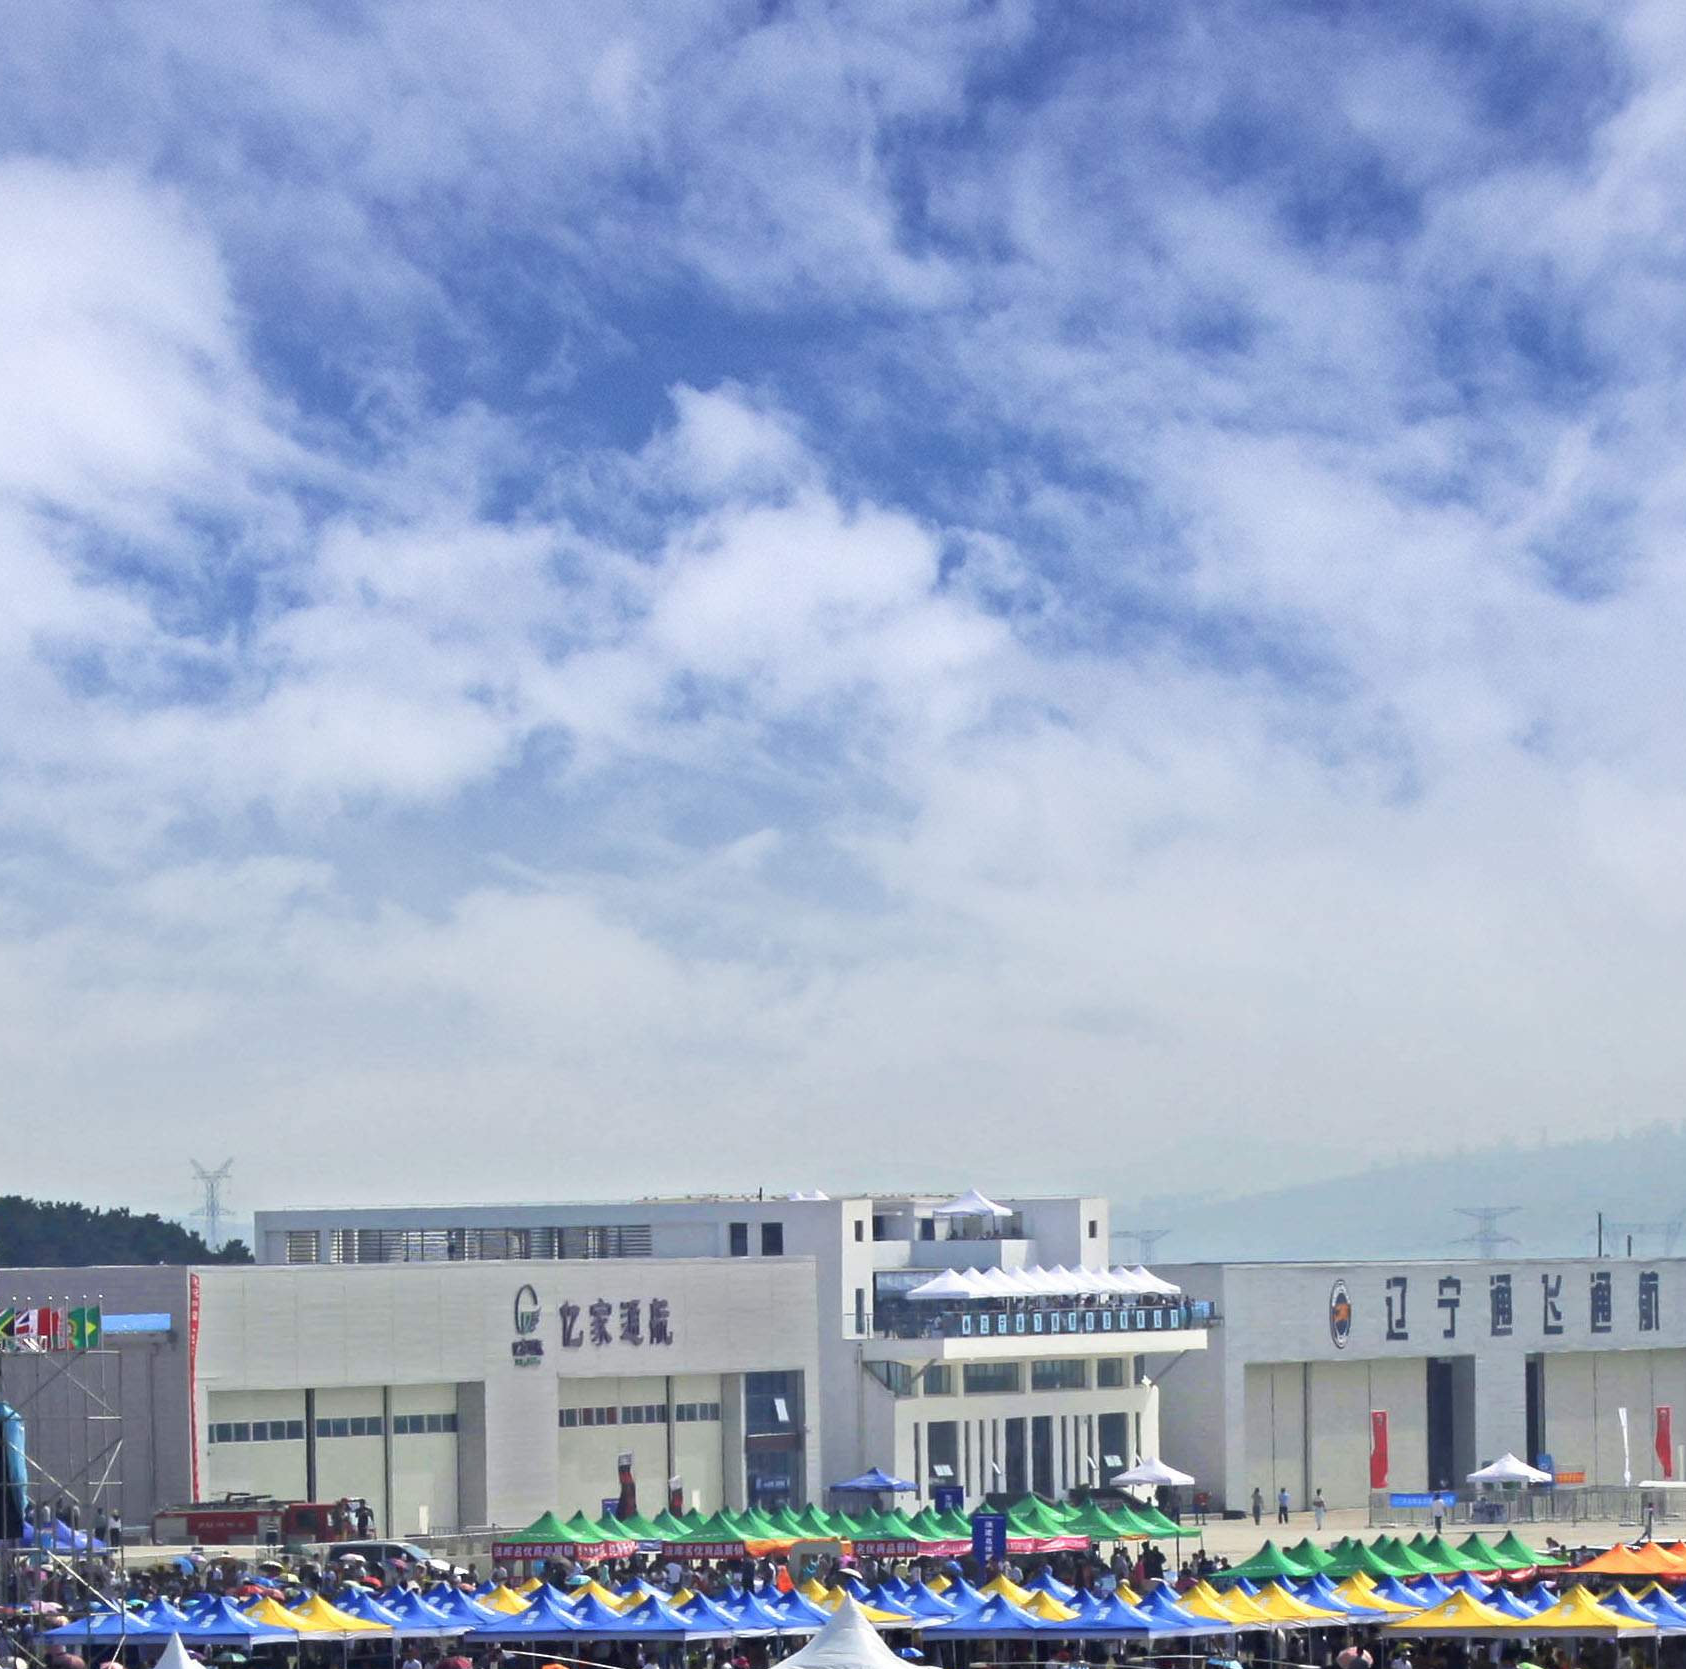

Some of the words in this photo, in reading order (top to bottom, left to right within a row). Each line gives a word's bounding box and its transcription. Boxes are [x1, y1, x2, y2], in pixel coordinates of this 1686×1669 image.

[559, 1298, 673, 1347] 亿家通航
[1386, 1270, 1660, 1341] 辽宁通飞通航
